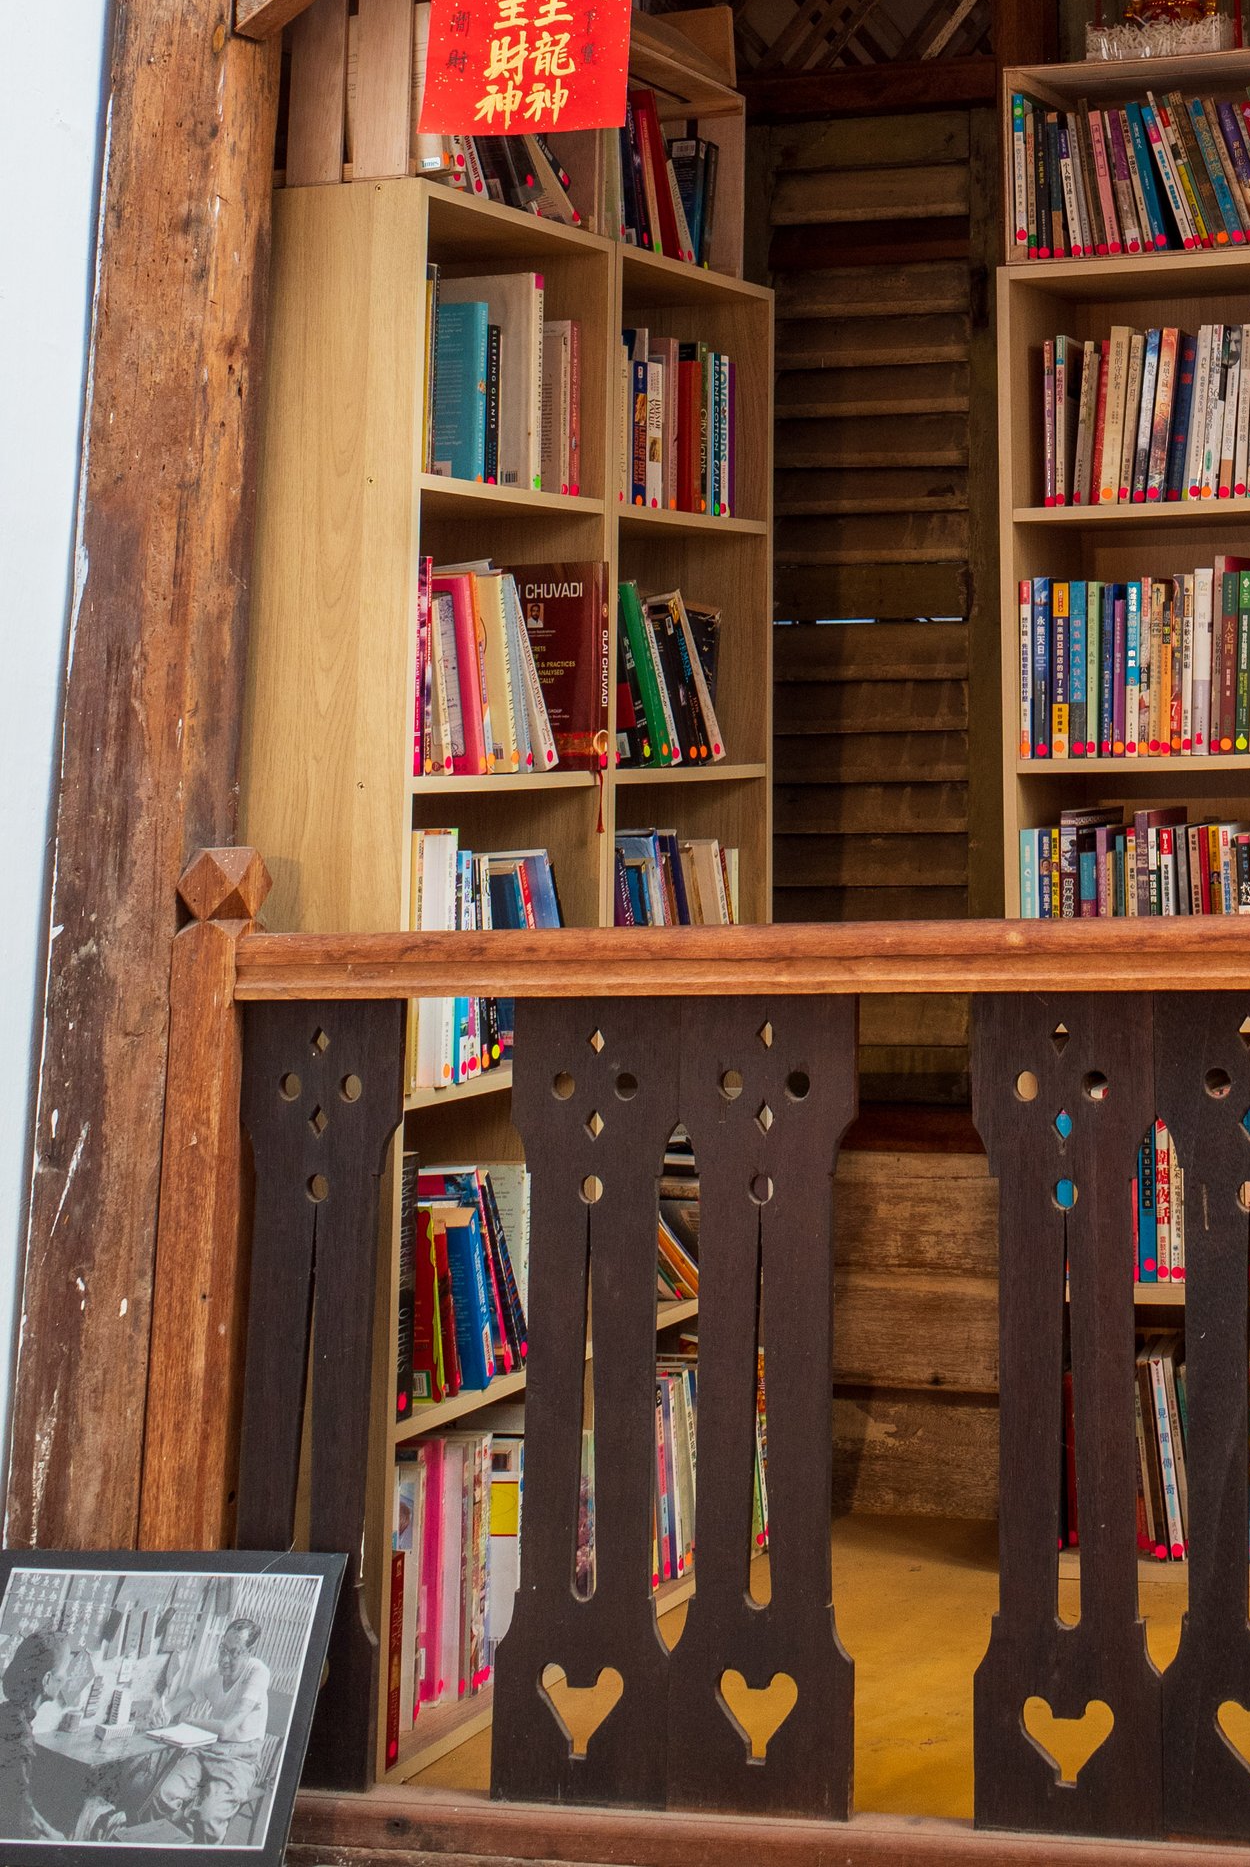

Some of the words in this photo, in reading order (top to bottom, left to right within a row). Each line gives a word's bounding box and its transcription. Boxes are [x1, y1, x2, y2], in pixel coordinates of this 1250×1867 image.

[638, 426, 646, 447] LINE
[638, 448, 646, 459] OF
[638, 460, 646, 486] DUTY
[525, 582, 583, 599] CHUVADI
[1036, 616, 1046, 655] 永無天日
[1224, 621, 1234, 655] 大宅門
[525, 645, 538, 685] EFFECTIVE
[534, 686, 545, 717] PEOPLE
[401, 1165, 410, 1217] JAMES
[397, 1307, 409, 1374] OTHERS
[1158, 1408, 1175, 1495] 見聞傳奇
